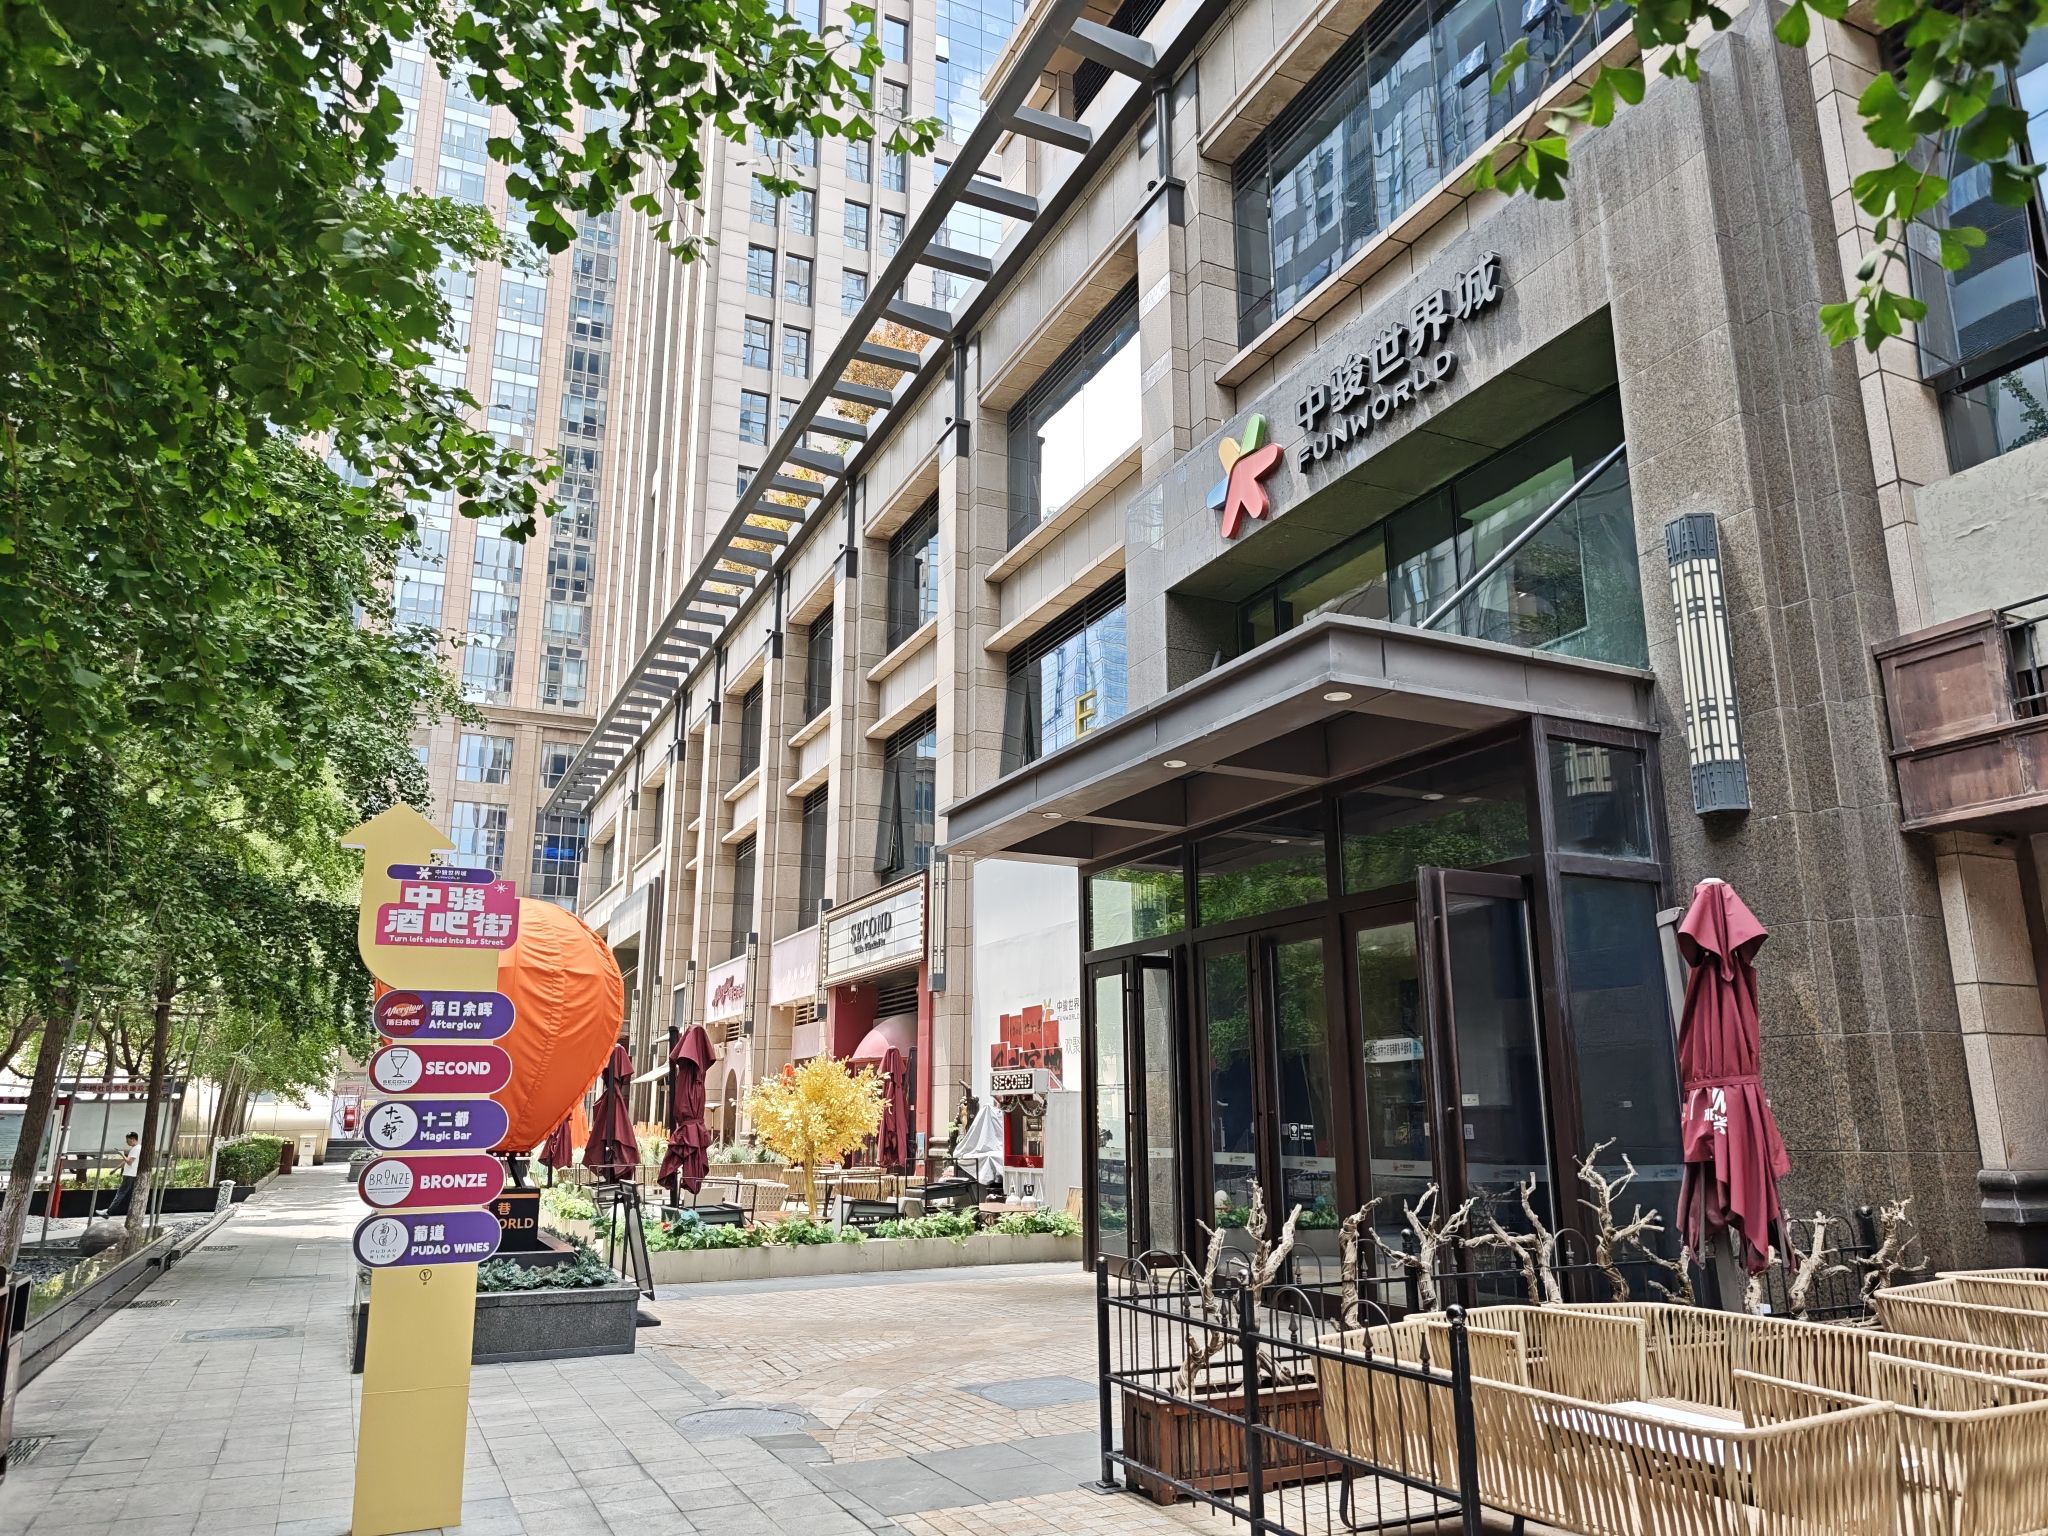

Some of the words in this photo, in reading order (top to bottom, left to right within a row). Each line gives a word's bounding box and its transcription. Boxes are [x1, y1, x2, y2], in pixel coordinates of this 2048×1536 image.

[1296, 250, 1503, 431] 中骏世界城
[1298, 351, 1458, 473] FUNWORLD
[404, 885, 486, 912] 中骏
[384, 909, 513, 937] 酒吧街
[850, 911, 893, 945] SECOND
[389, 935, 408, 943] Turn
[381, 1003, 425, 1017] Afterglow
[430, 1001, 493, 1018] 落日余晖
[428, 1019, 482, 1032] Afterglow
[425, 1061, 491, 1076] SECOND
[993, 1073, 1031, 1090] SECOND
[422, 1111, 470, 1128] 十二都
[420, 1131, 451, 1143] Magic
[453, 1131, 472, 1141] Bar
[368, 1169, 410, 1186] BRONZE
[420, 1173, 488, 1190] BRONZE
[414, 1224, 445, 1242] 葡道
[411, 1244, 451, 1257] PUDAO
[454, 1242, 490, 1254] WINES
